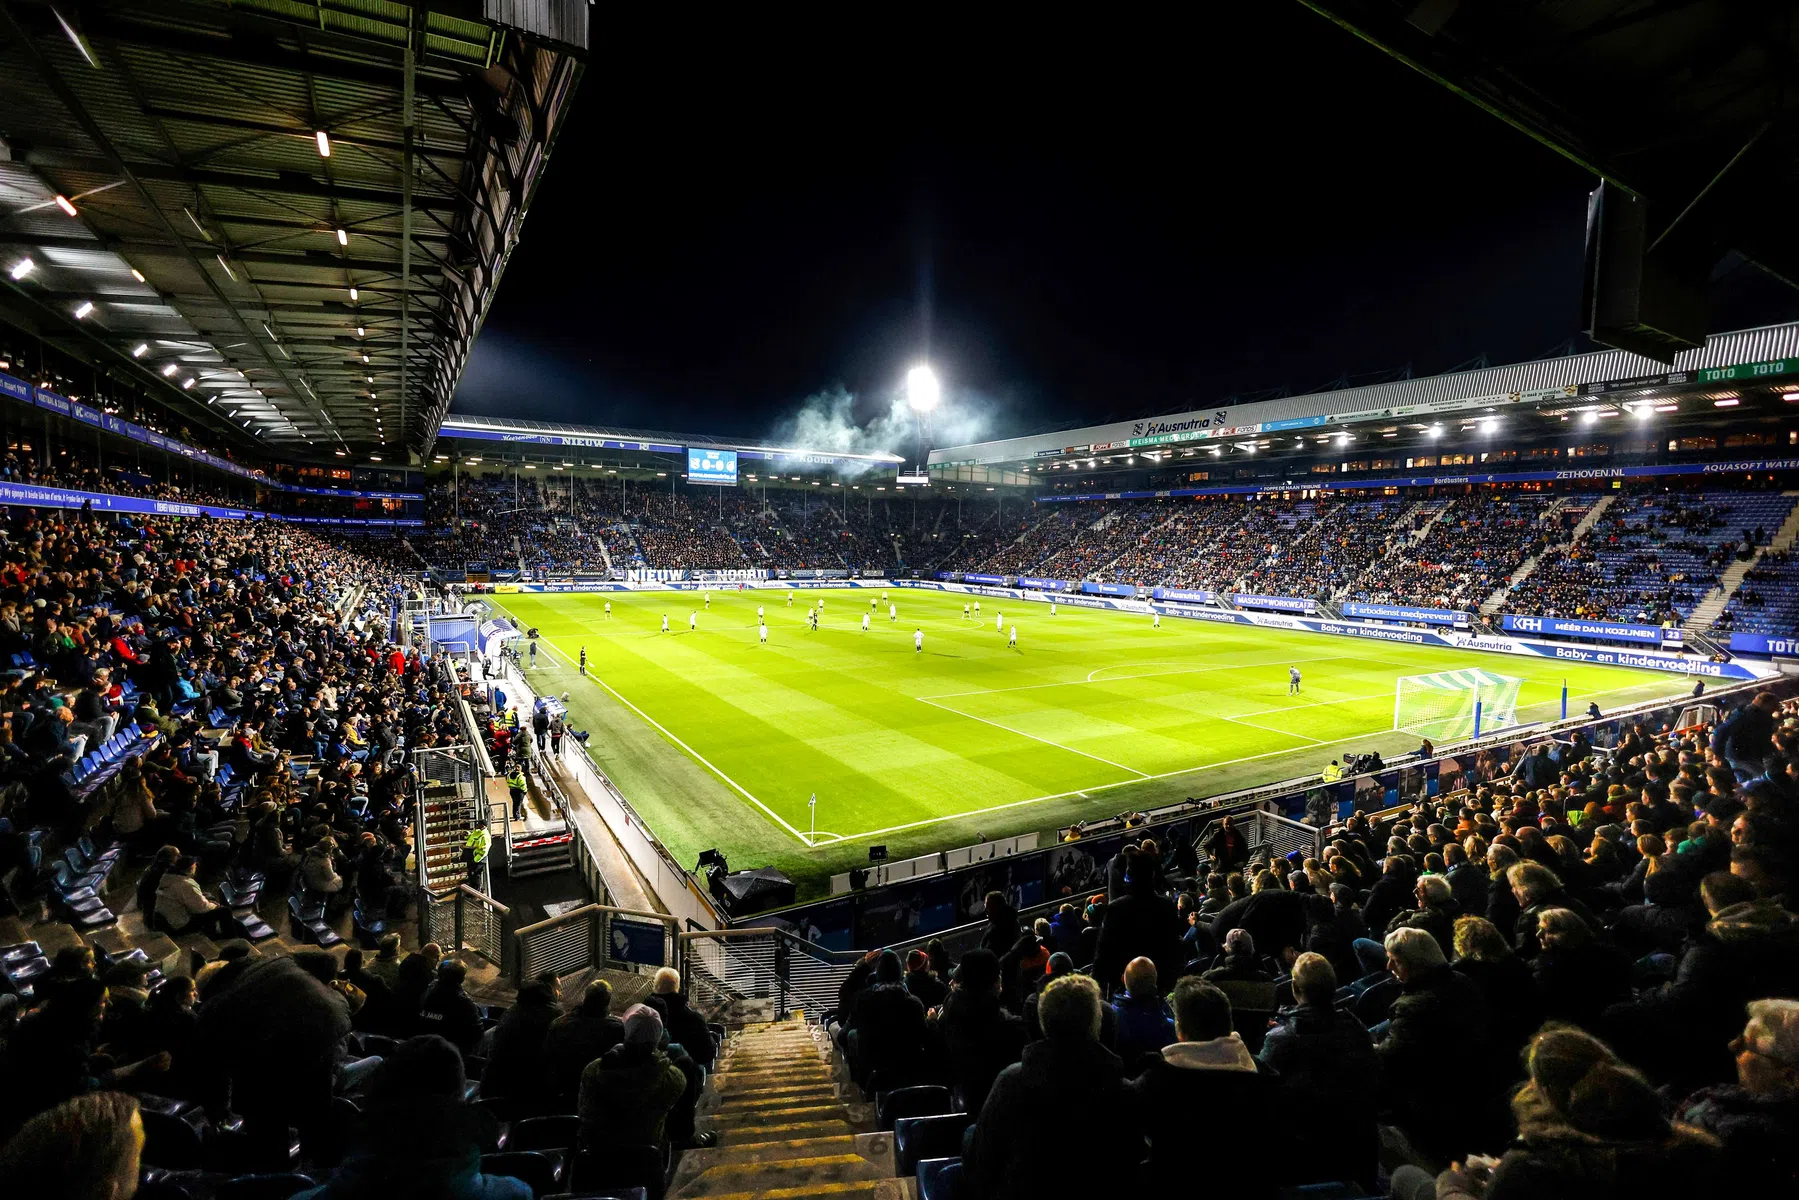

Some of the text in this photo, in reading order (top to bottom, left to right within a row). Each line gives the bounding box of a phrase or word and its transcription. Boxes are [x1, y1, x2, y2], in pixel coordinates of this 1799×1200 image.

[1706, 368, 1735, 380] TOTO
[1753, 362, 1784, 375] TOTO
[1158, 417, 1210, 434] Ausnutria
[562, 438, 605, 448] NIEUW
[1138, 436, 1158, 445] EISMA
[800, 455, 834, 464] NOORD
[1703, 462, 1762, 472] AQUASOFT
[1556, 468, 1625, 479] ZETHOVEN.NL
[628, 570, 683, 582] NIEUW
[717, 569, 768, 580] NOORD
[1170, 591, 1200, 600] Ausnutria
[1166, 608, 1181, 616] Baby-
[1192, 610, 1234, 622] kindervoeding
[1359, 608, 1400, 618] arbodienst
[1264, 618, 1293, 628] Ausnutria
[1321, 624, 1344, 634] Baby-
[1360, 627, 1422, 643] kindervoeding
[1583, 626, 1603, 634] DAN
[1604, 627, 1655, 638] KOZIJNEN
[1667, 630, 1679, 639] 23
[1467, 639, 1512, 651] Ausnutria
[1556, 648, 1721, 675] Baby- en kindervoeding
[426, 1012, 443, 1020] JAKO
